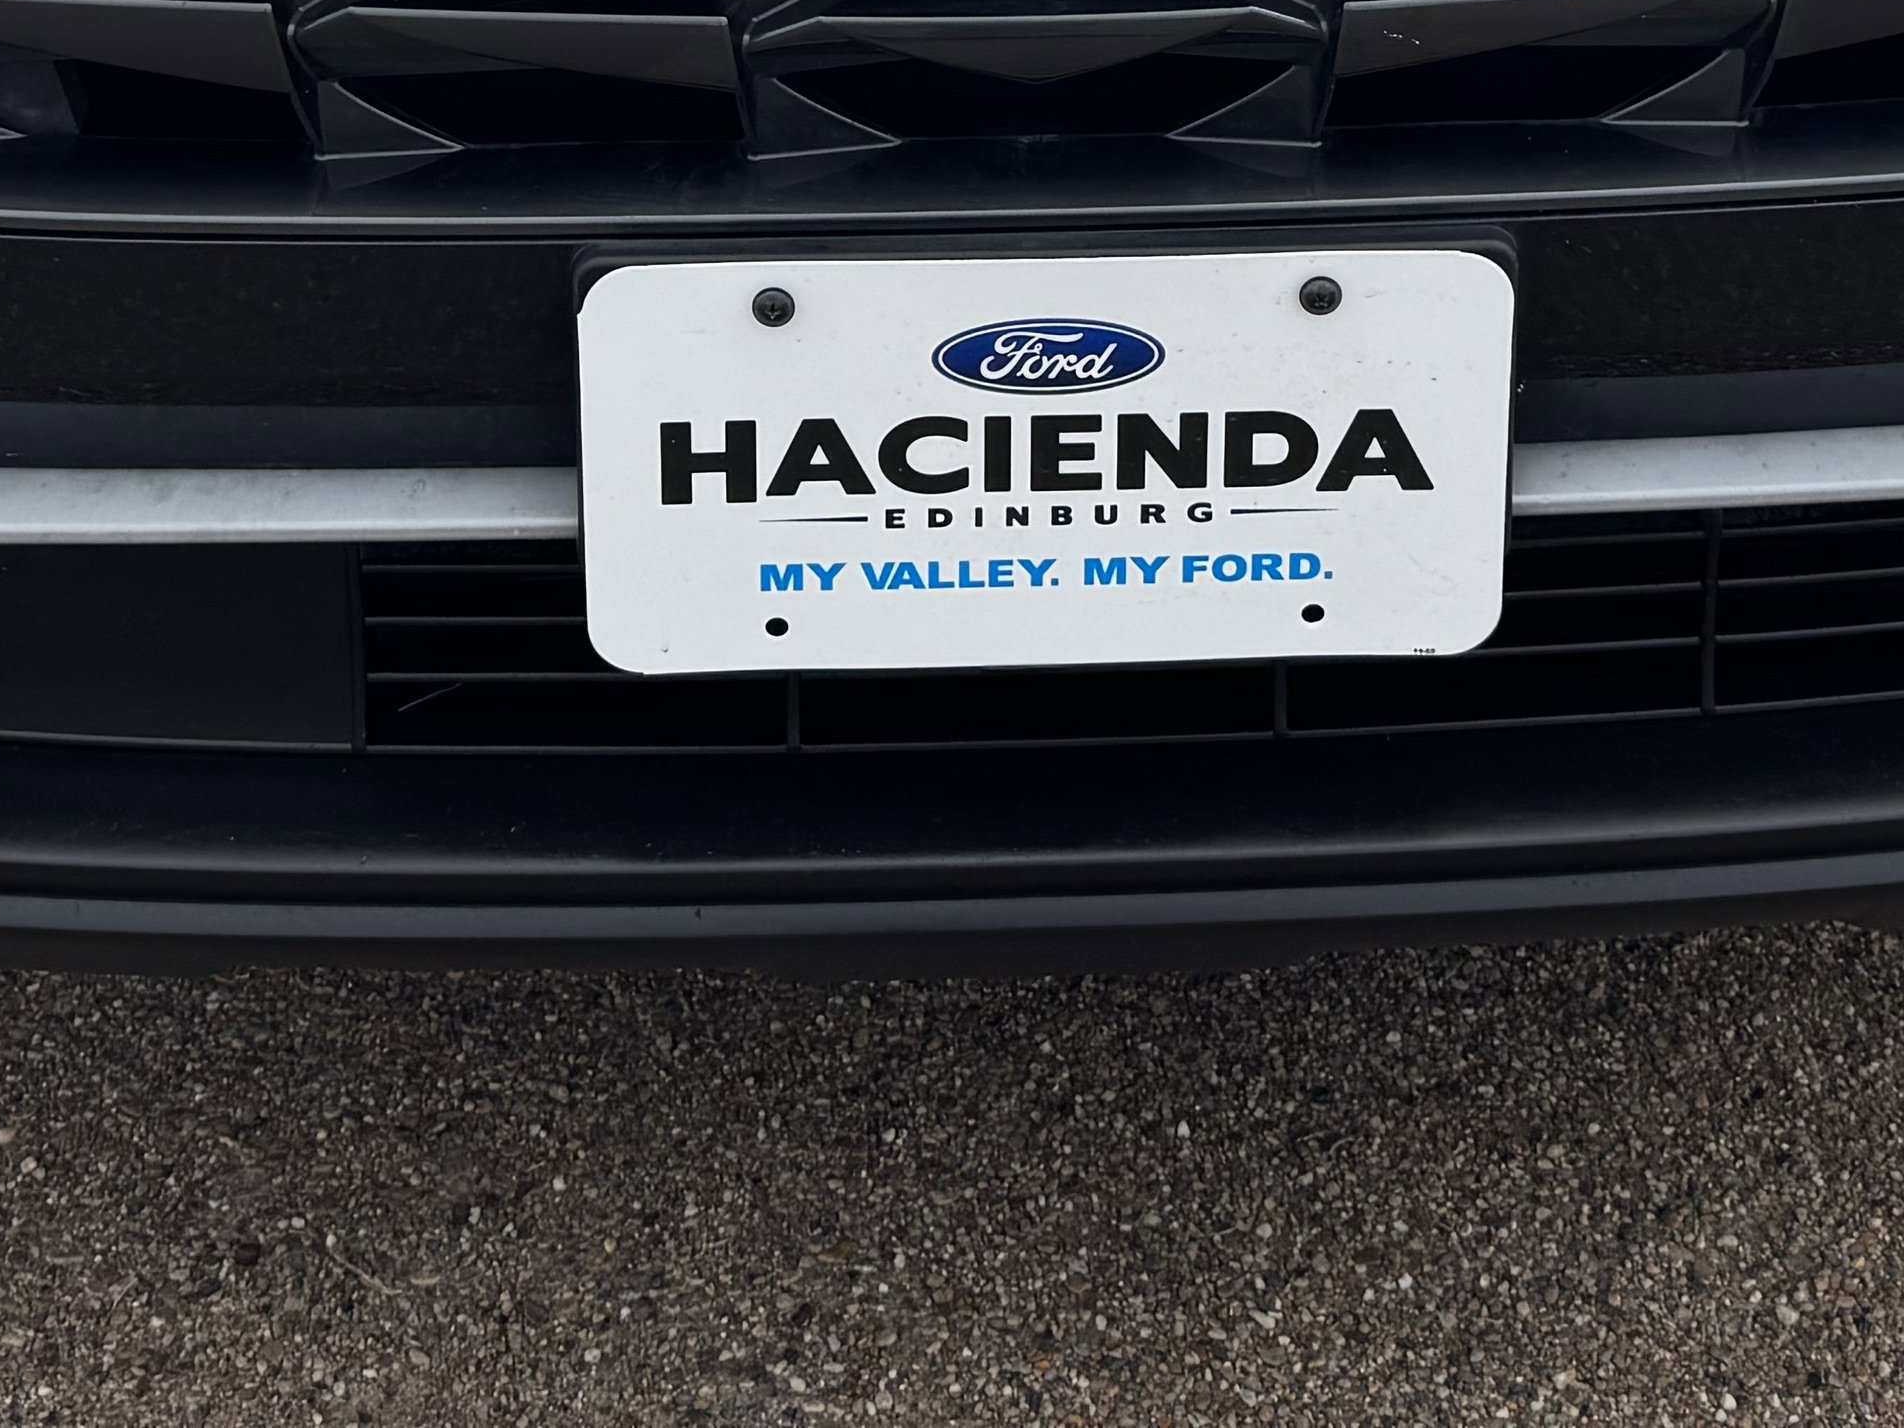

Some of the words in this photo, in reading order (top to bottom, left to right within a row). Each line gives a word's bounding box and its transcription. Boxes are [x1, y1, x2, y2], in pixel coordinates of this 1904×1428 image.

[980, 331, 1118, 380] Ford
[660, 409, 1434, 505] HACIENDA
[885, 502, 1214, 529] EDINBURG
[760, 563, 845, 592] MY
[862, 558, 1060, 591] VALLEY.
[1083, 555, 1167, 587] MY
[1181, 551, 1333, 584] FORD.
